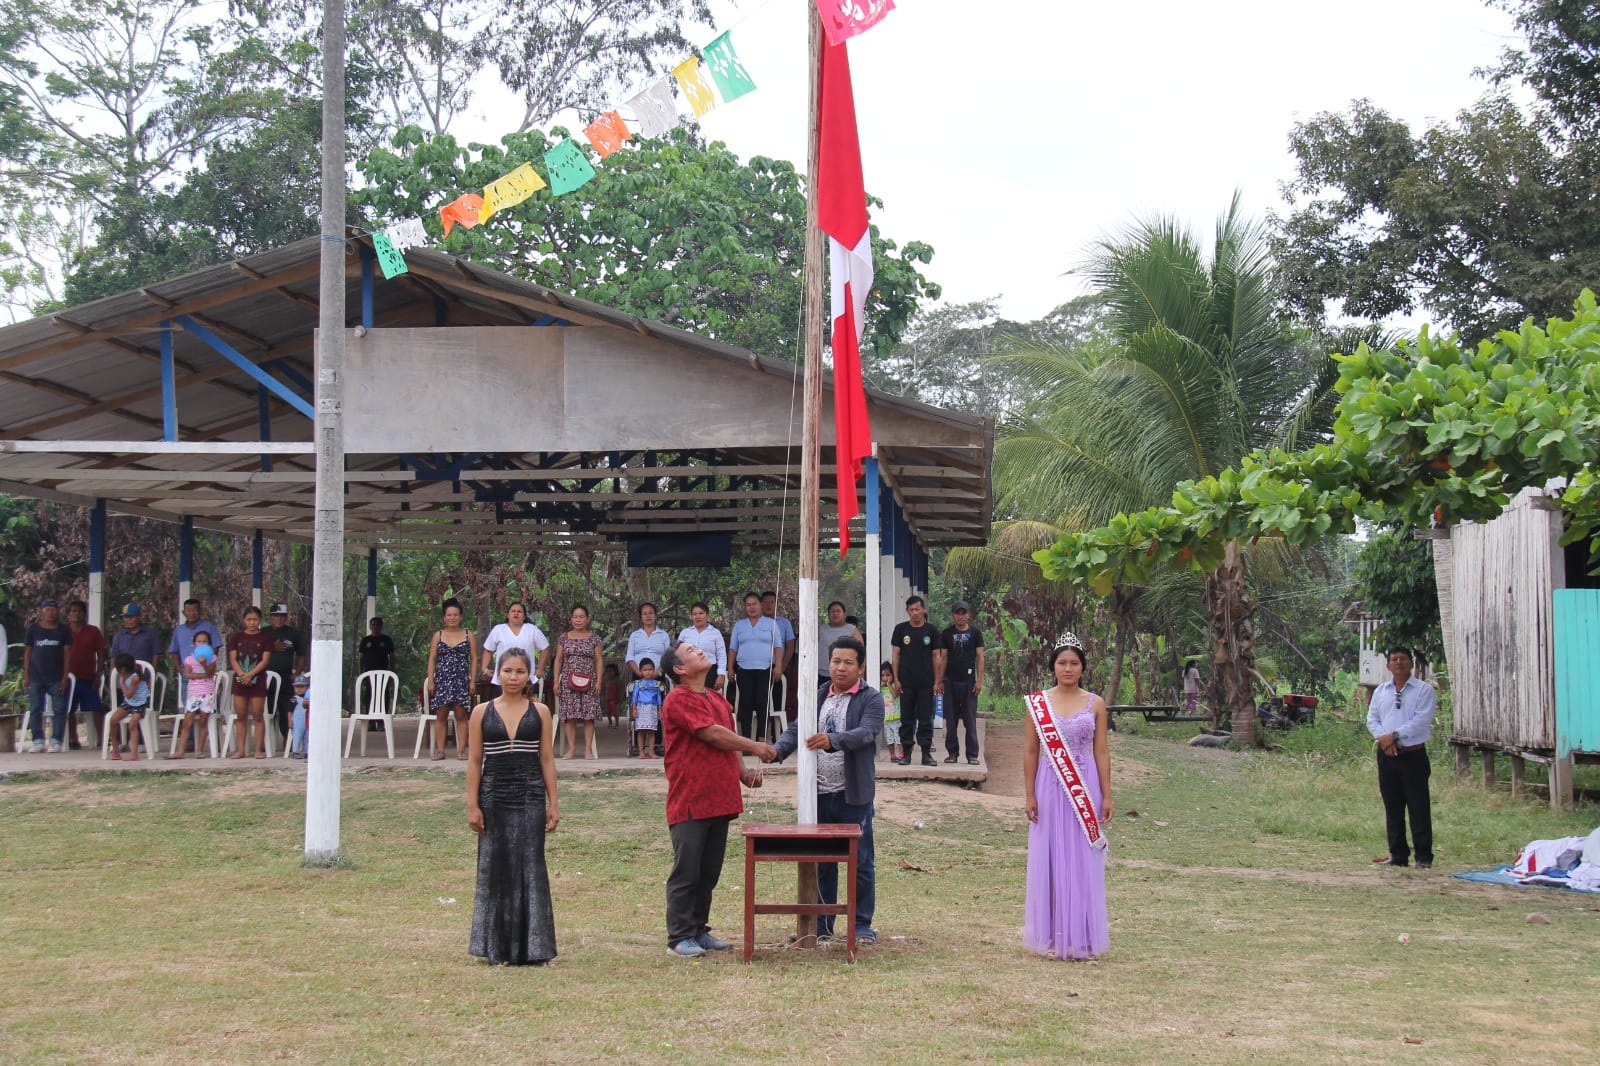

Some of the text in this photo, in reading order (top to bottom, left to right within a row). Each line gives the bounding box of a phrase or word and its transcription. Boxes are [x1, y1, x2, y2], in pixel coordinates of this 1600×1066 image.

[1030, 694, 1045, 722] Srta.
[1051, 747, 1075, 783] Santa
[1070, 784, 1091, 819] Clara
